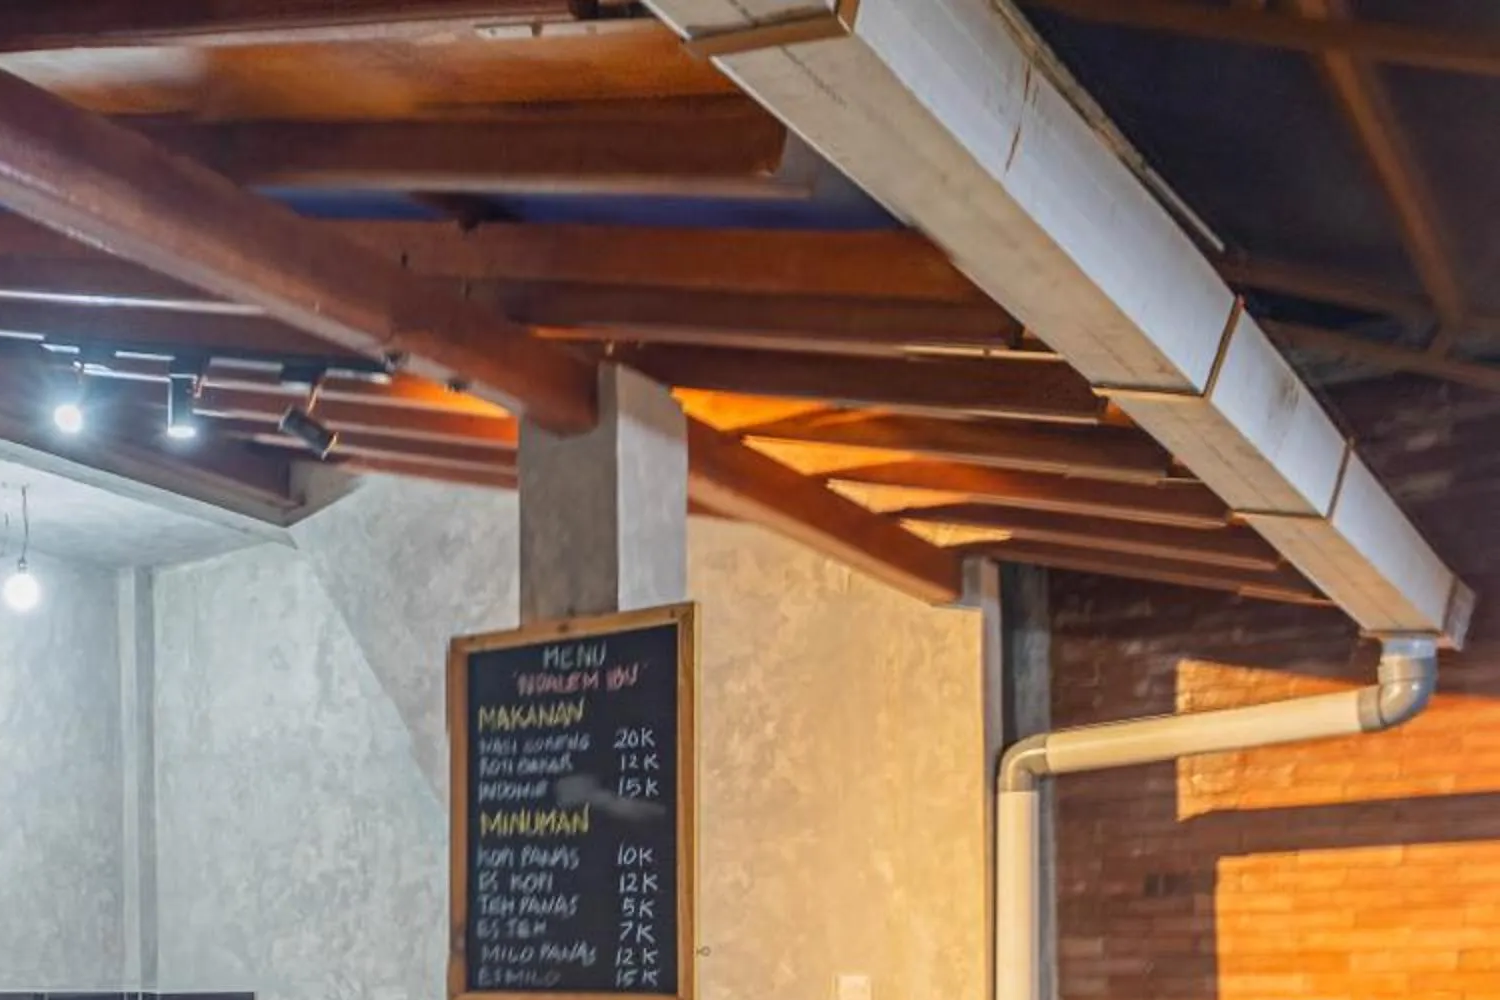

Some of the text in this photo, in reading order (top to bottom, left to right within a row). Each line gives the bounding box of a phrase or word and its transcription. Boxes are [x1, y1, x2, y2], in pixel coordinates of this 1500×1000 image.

[542, 640, 607, 669] MENU
[478, 697, 585, 733] MAKANAN
[613, 727, 656, 749] 20K
[480, 802, 591, 837] MINUMAN
[520, 844, 580, 870] PANAS
[617, 841, 654, 867] 10K
[509, 871, 554, 894] KOPI
[518, 894, 580, 918] PANAS
[481, 943, 535, 963] MILO
[539, 940, 597, 966] PANAS
